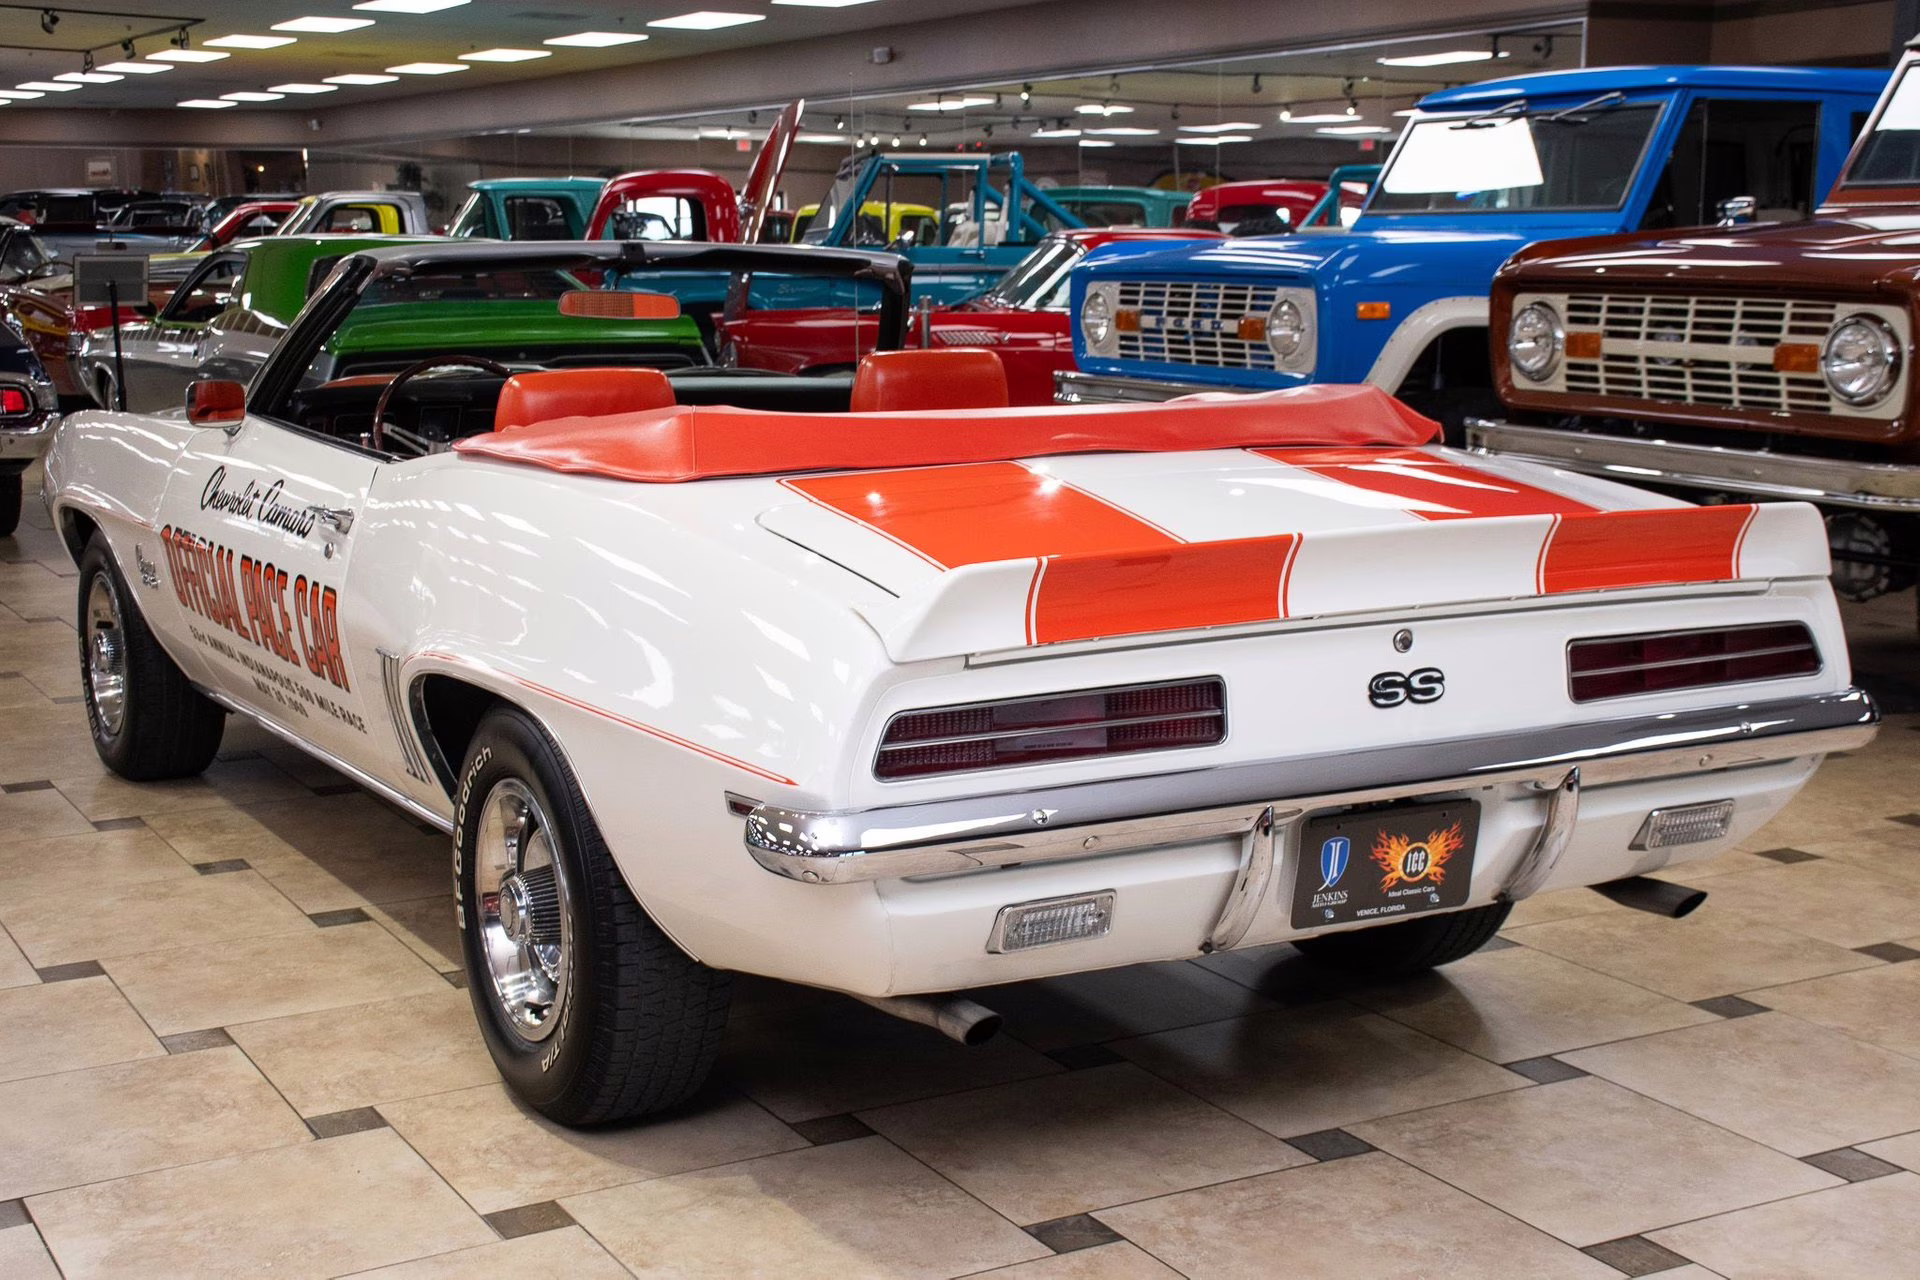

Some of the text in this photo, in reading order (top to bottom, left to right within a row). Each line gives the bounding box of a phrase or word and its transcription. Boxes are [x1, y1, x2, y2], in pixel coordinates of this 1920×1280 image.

[1155, 317, 1223, 331] FORD
[201, 465, 316, 539] Chevrolet Camaro
[160, 523, 252, 642] OFFICIAL
[240, 554, 301, 668] PACE
[294, 574, 351, 694] CAR
[207, 634, 240, 663] ANNUAL
[237, 650, 296, 695] INDIANAPOLIS
[294, 681, 315, 706] 500
[314, 692, 341, 719] MILE
[339, 704, 368, 735] RACE
[251, 675, 274, 698] MAY
[1368, 667, 1445, 709] SS
[454, 745, 493, 931] BFGoodrich
[1405, 850, 1426, 873] ICC
[1312, 890, 1349, 904] JENKINS
[1387, 885, 1436, 898] Ideal Classic Cars
[1379, 903, 1407, 914] FLORIDA
